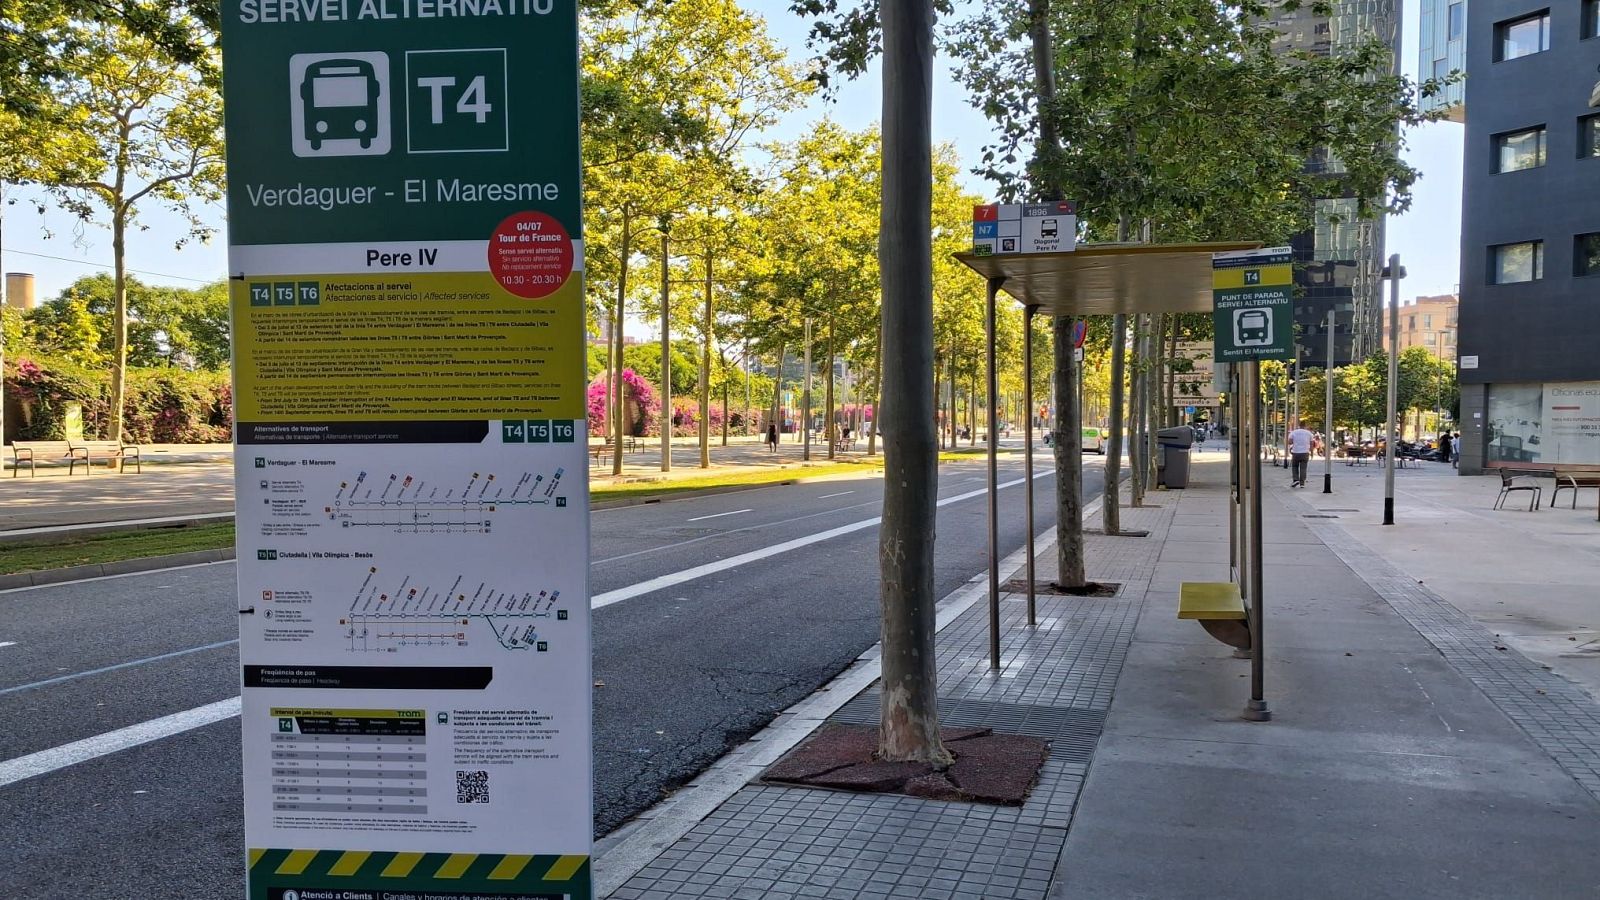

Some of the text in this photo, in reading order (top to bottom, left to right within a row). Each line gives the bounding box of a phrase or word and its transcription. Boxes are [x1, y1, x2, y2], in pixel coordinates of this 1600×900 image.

[239, 0, 554, 23] SERVEI ALTERNATIU
[417, 75, 493, 125] T4
[246, 182, 376, 211] Verdaguer
[404, 179, 427, 203] El
[437, 178, 559, 202] Maresme
[982, 208, 989, 218] 7
[1028, 208, 1048, 217] 1896
[516, 222, 542, 231] 04/07
[978, 225, 992, 235] N7
[498, 233, 562, 243] Tour de France
[1033, 238, 1060, 246] Diagonal
[366, 248, 438, 267] Pere IV
[502, 276, 524, 285] 10.30
[532, 275, 555, 284] 20.30
[556, 275, 562, 283] h
[1245, 272, 1258, 282] T4
[325, 283, 375, 291] Afectacions
[386, 282, 412, 290] servei
[252, 288, 269, 300] T4
[276, 287, 293, 300] T5
[300, 287, 318, 300] T6
[325, 292, 375, 302] Afectaciones
[378, 293, 385, 301] al
[387, 292, 418, 300] servicio
[424, 292, 457, 300] Affected
[459, 292, 490, 300] services
[1254, 291, 1284, 299] PARADA
[1244, 298, 1288, 306] ALTERNATIU
[300, 425, 329, 433] transport
[504, 425, 523, 437] T4
[529, 425, 548, 437] T5
[554, 425, 573, 437] T6
[280, 721, 291, 729] T4
[300, 891, 333, 900] Atenció
[342, 891, 373, 900] Clients
[383, 892, 416, 900] Canales
